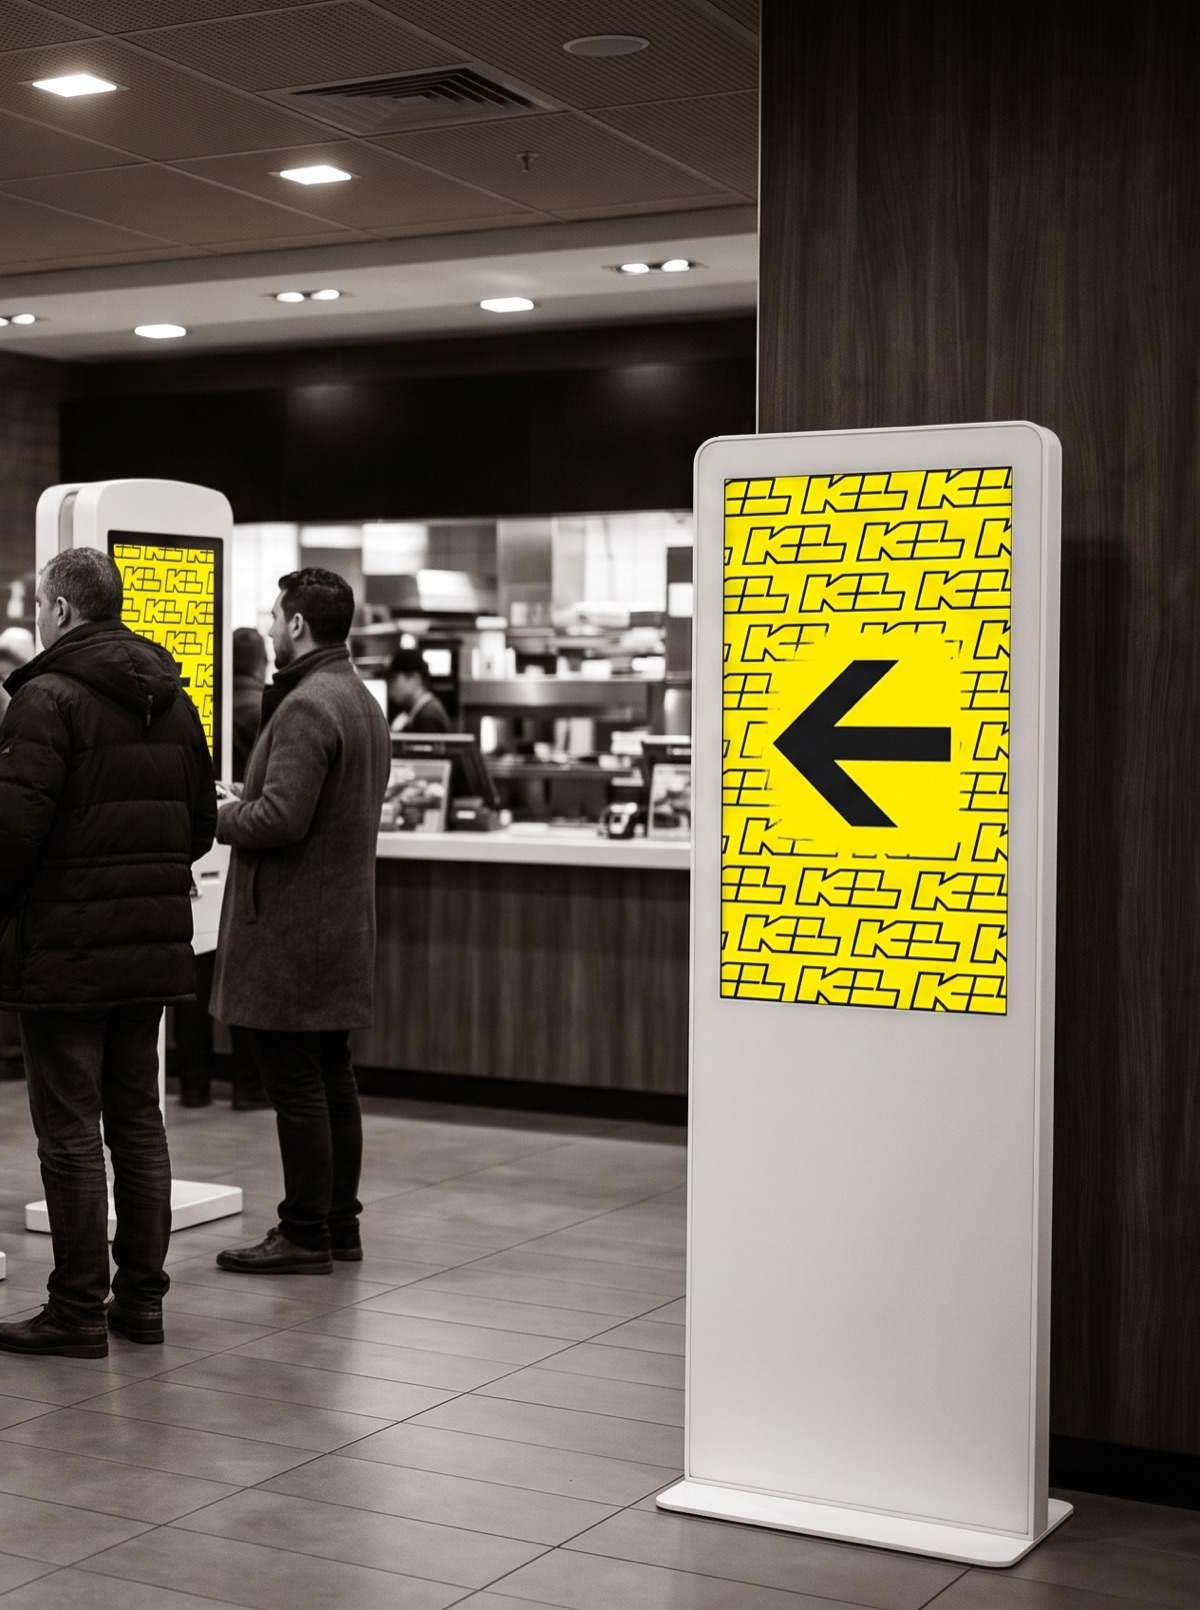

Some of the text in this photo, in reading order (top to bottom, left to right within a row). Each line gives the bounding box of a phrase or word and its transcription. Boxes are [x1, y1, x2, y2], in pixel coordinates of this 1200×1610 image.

[742, 524, 847, 565] KL
[856, 521, 965, 562] KL
[165, 568, 203, 594] KL
[798, 573, 905, 612] KL
[143, 598, 182, 624] KL
[795, 868, 901, 909] KL
[738, 914, 841, 956] KL
[850, 919, 960, 961] KL
